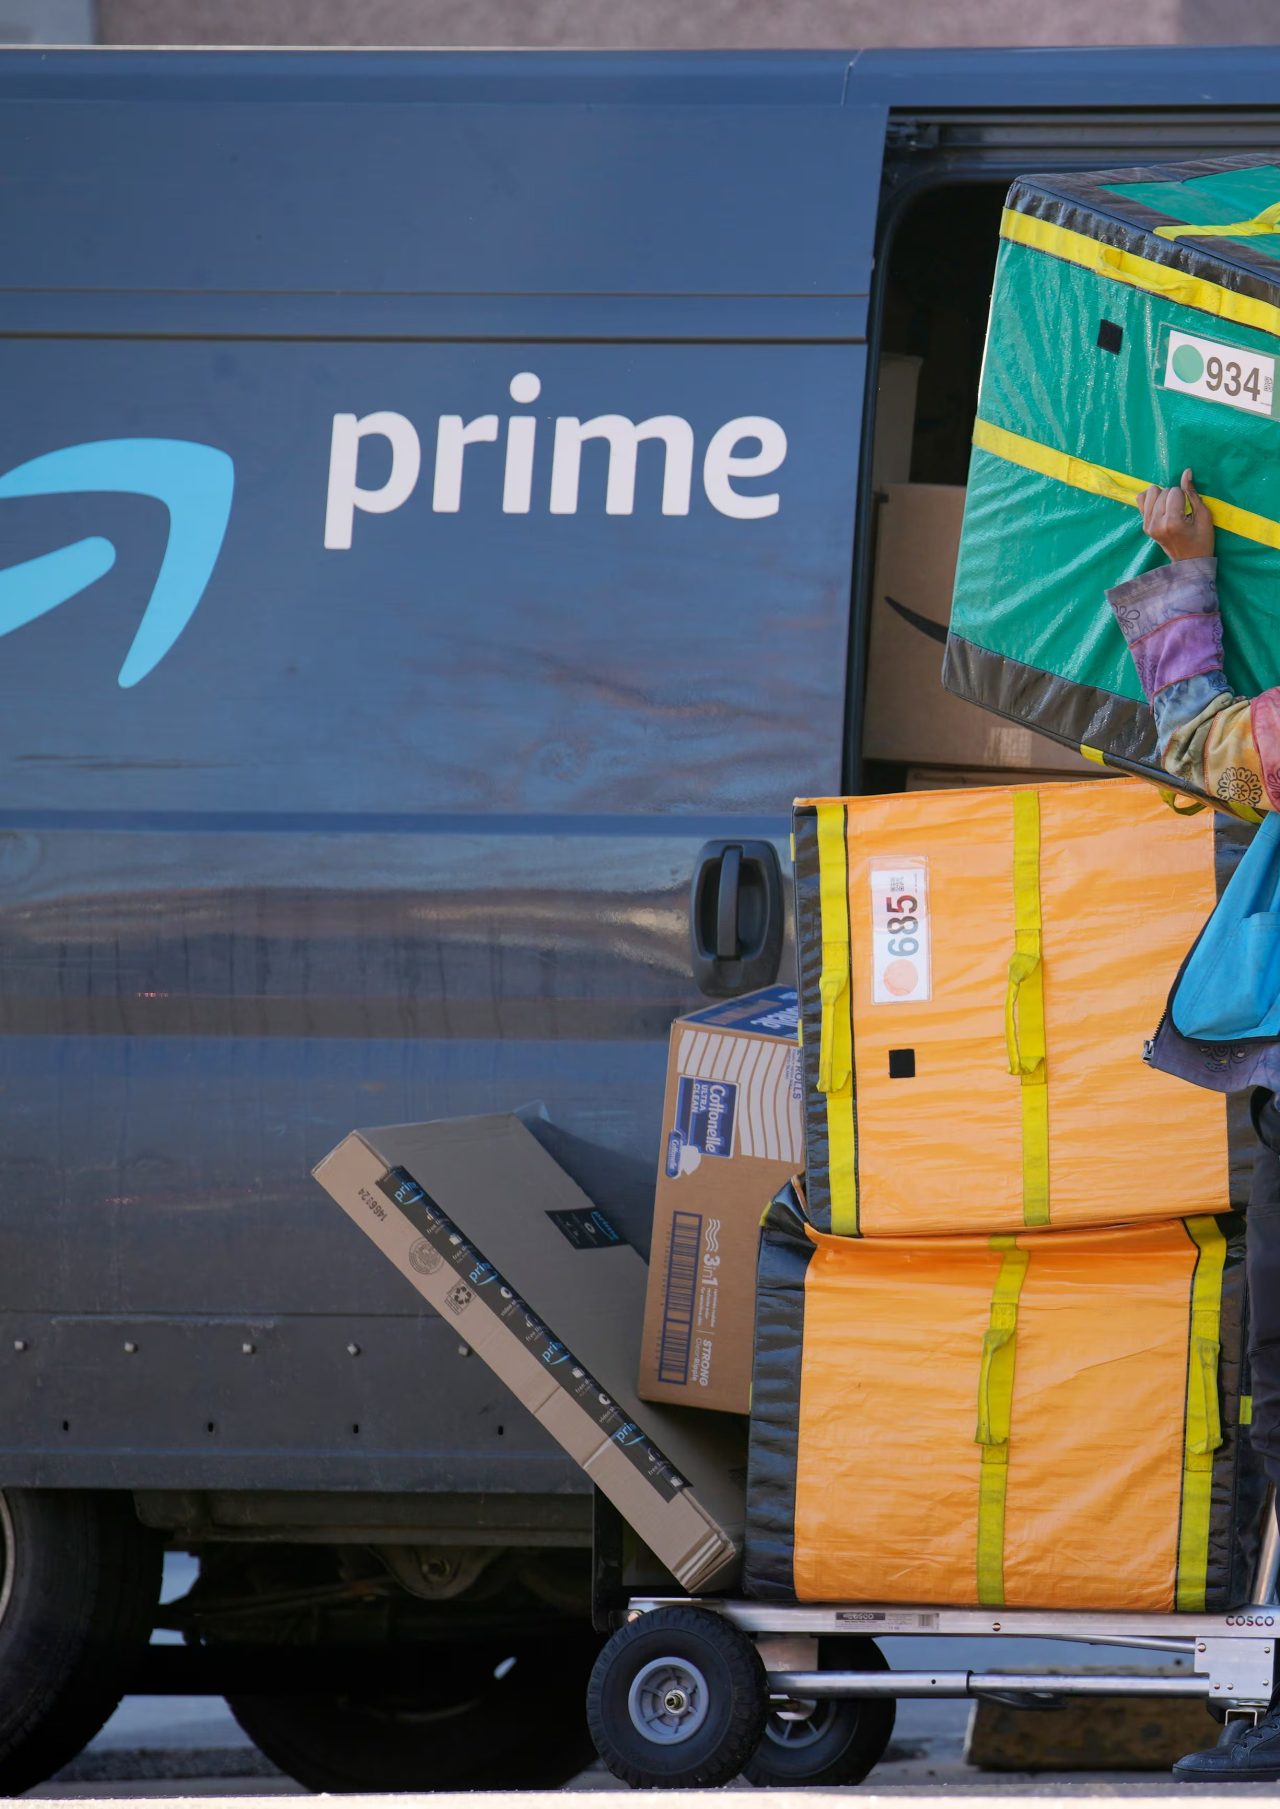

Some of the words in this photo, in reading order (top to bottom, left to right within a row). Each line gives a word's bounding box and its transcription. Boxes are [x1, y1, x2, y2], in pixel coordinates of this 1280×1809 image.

[1206, 356, 1261, 402] 934
[324, 371, 788, 550] prime
[886, 894, 919, 957] 685
[692, 1083, 700, 1113] CLEAN
[699, 1085, 708, 1111] ULTRA
[705, 1084, 726, 1152] Cottonelle
[699, 1339, 712, 1386] STRONG
[1225, 1615, 1275, 1627] COSCO
